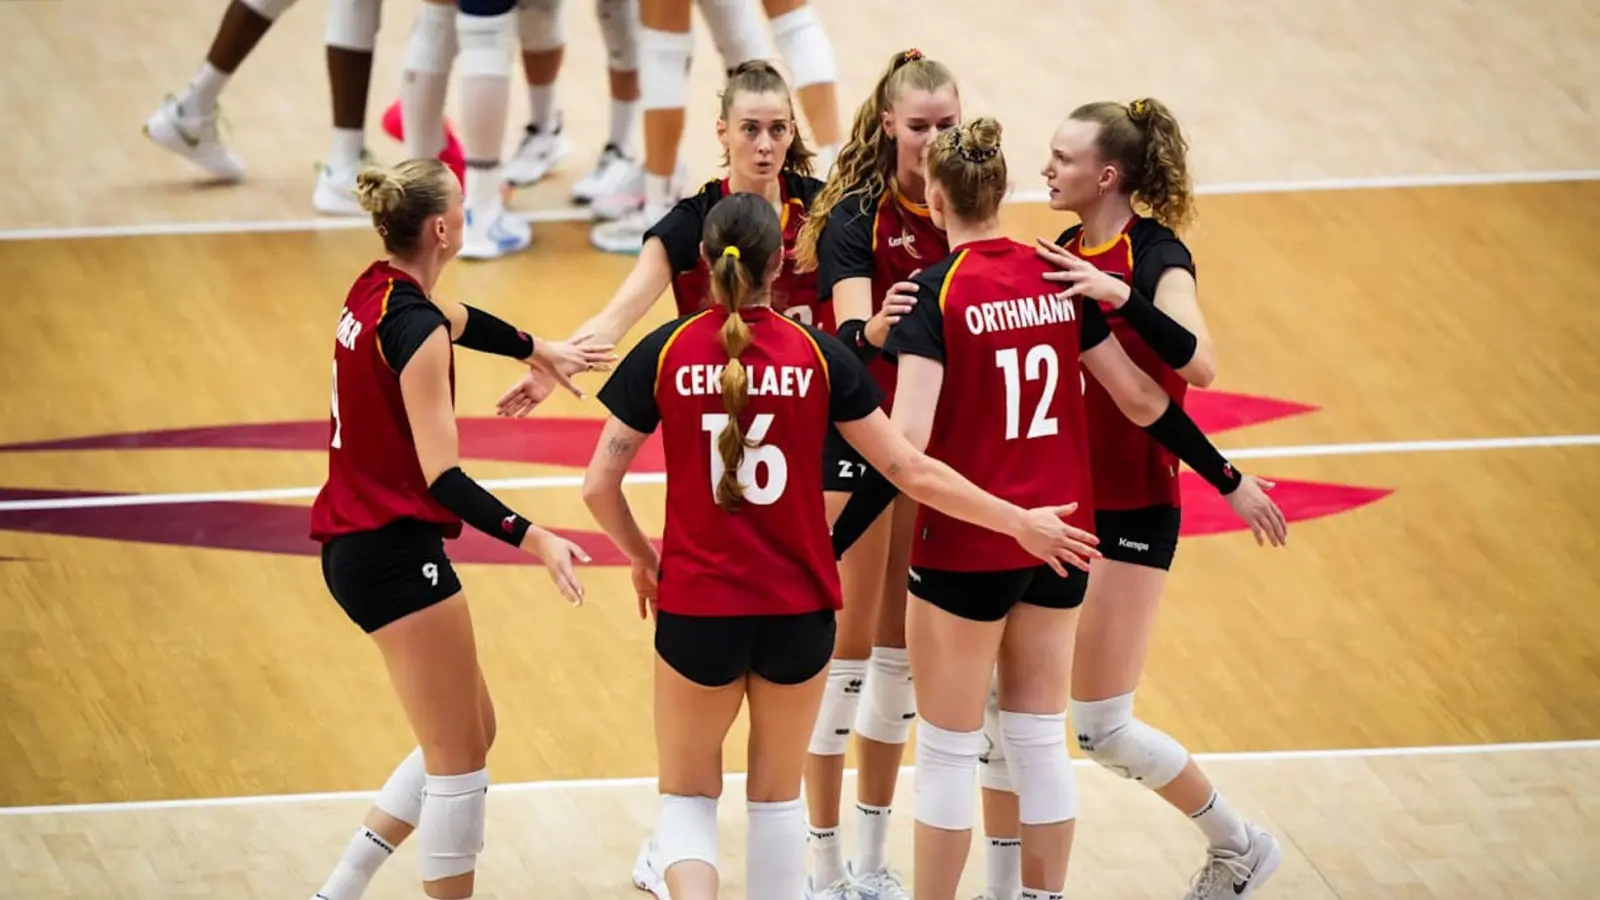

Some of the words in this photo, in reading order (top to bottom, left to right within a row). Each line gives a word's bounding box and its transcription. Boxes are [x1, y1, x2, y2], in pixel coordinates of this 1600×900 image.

[965, 293, 1076, 336] ORTHMANN
[675, 364, 814, 398] CEKLAEV
[995, 343, 1059, 441] 12
[701, 413, 788, 506] 16
[422, 562, 438, 587] 9
